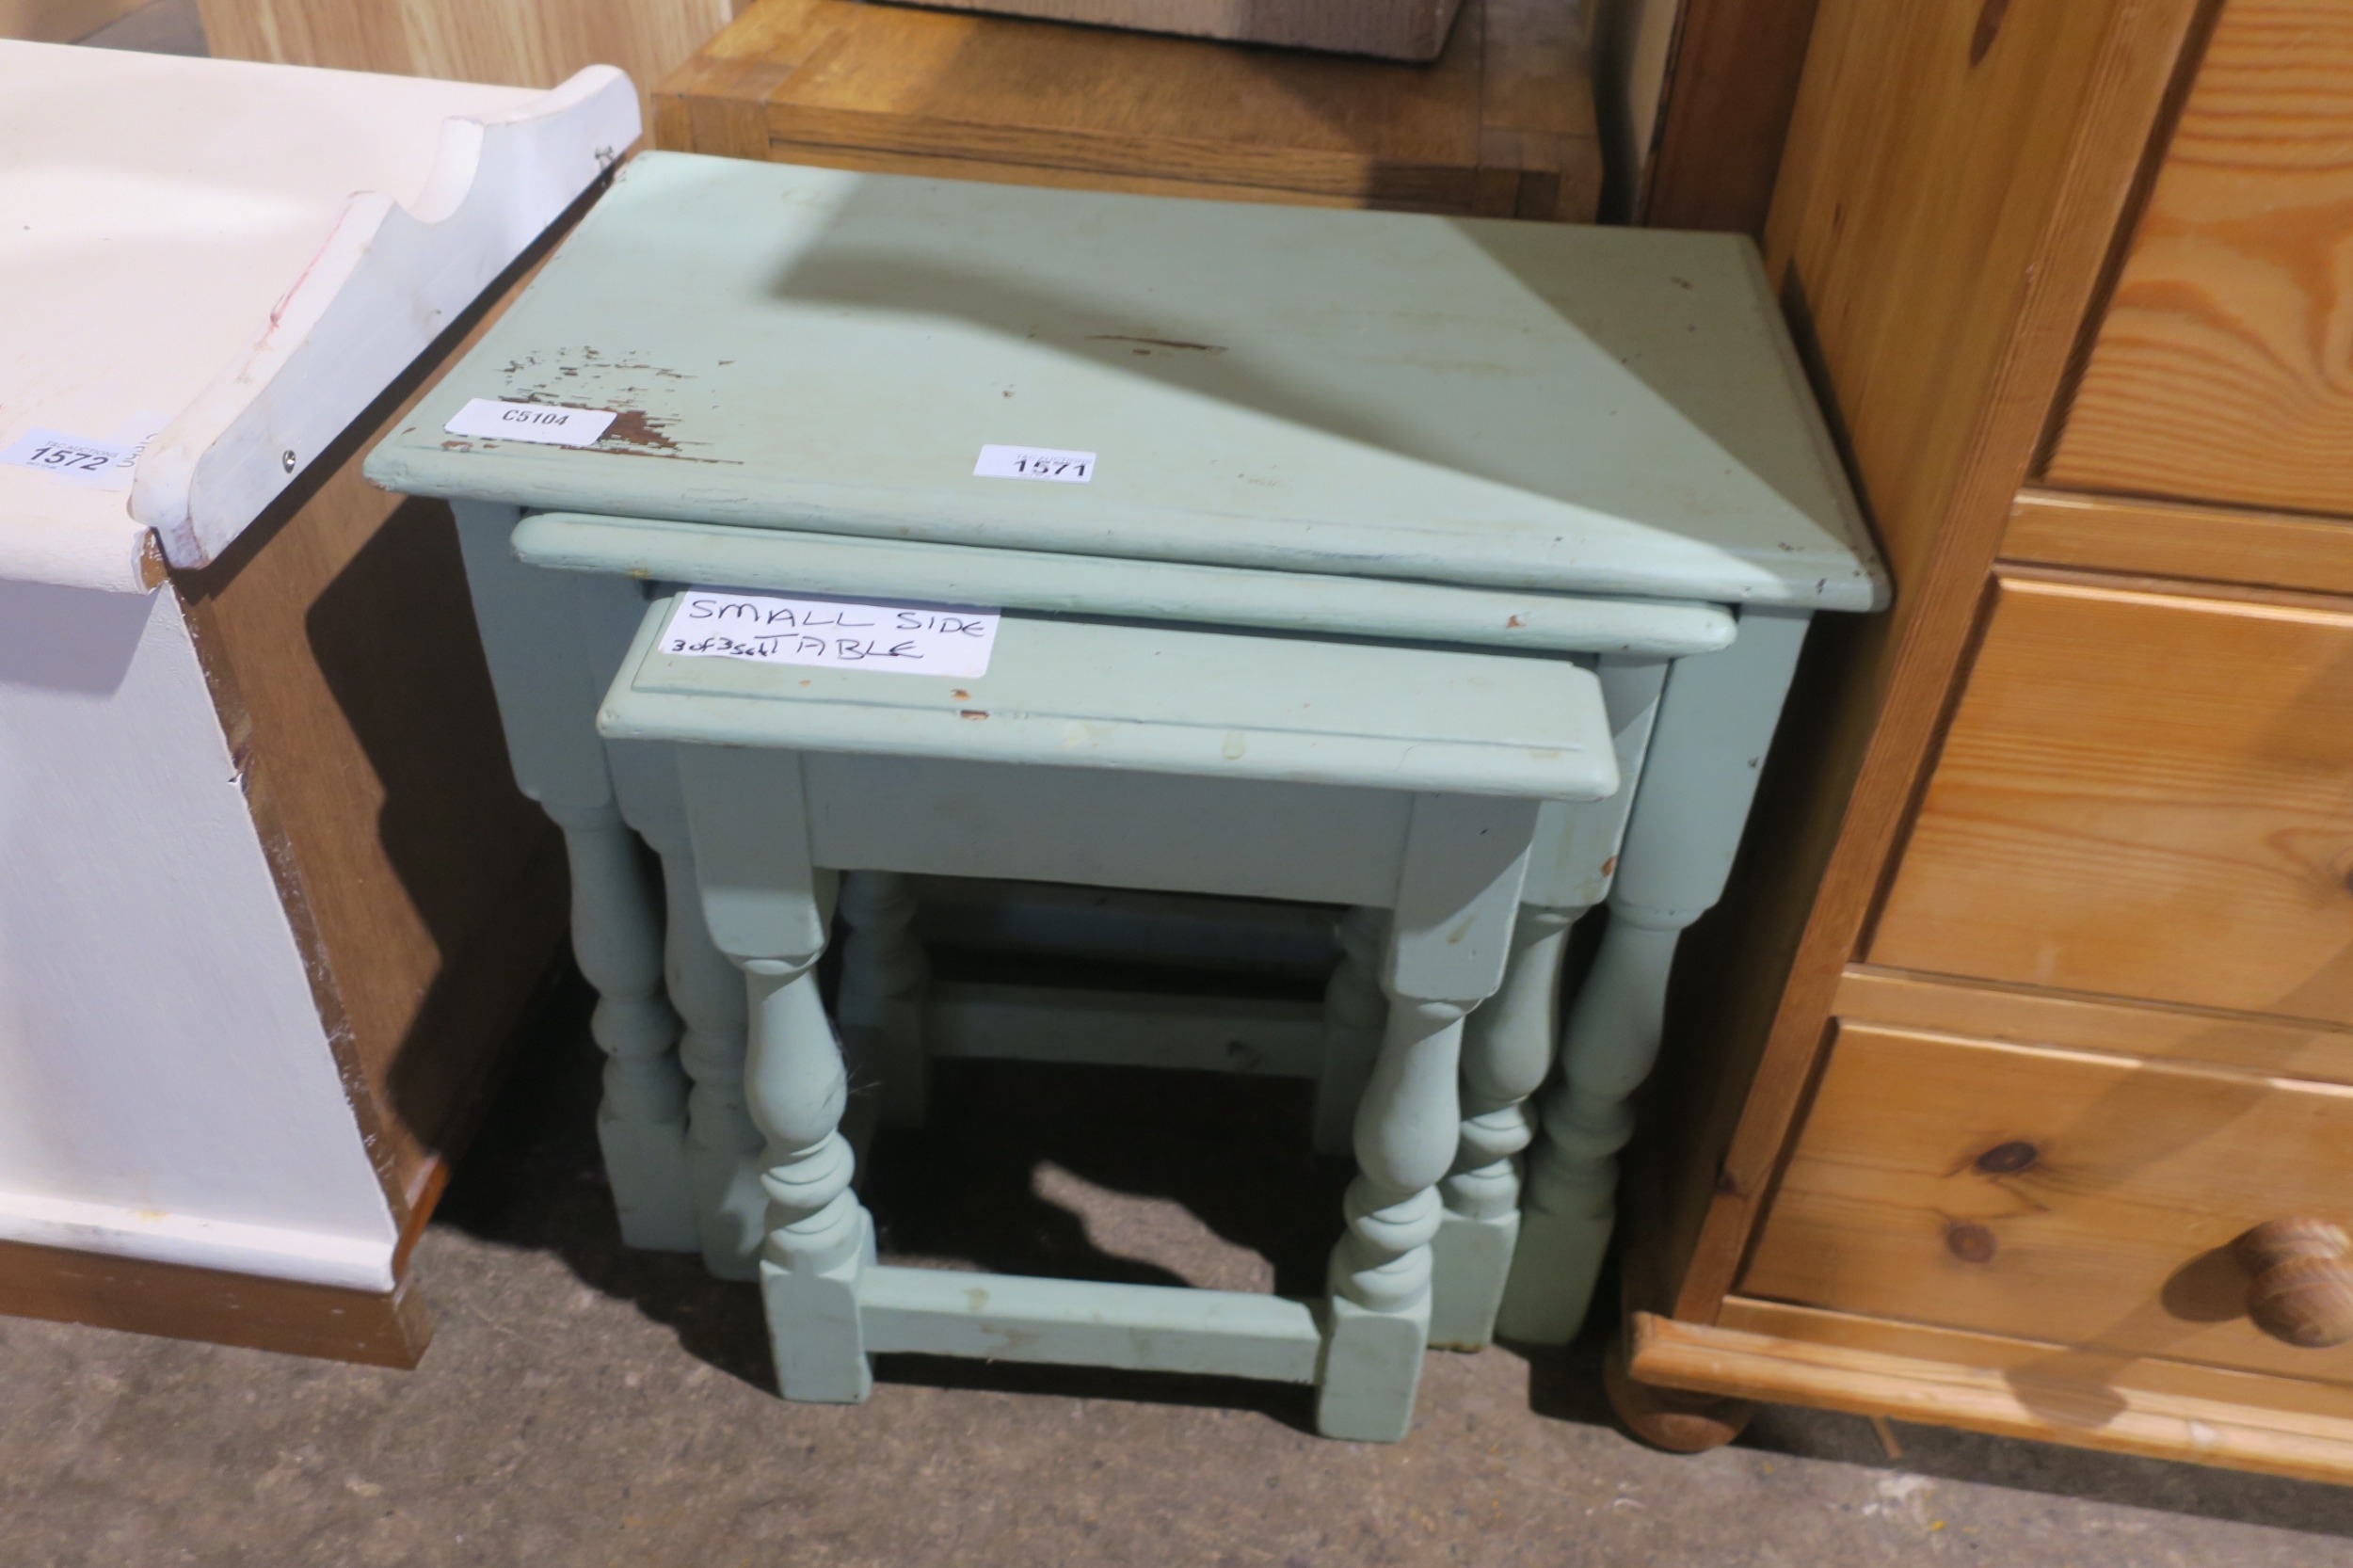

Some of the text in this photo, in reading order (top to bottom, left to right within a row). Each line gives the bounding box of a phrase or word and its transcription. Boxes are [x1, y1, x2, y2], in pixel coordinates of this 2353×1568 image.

[502, 409, 569, 426] C5104
[30, 447, 109, 471] 1572
[66, 444, 120, 458] AUCTIONS
[1013, 458, 1086, 477] 1571
[688, 600, 985, 637] SMALL SIDE
[672, 639, 687, 652] 3
[689, 636, 715, 652] of
[754, 633, 924, 660] TABLE
